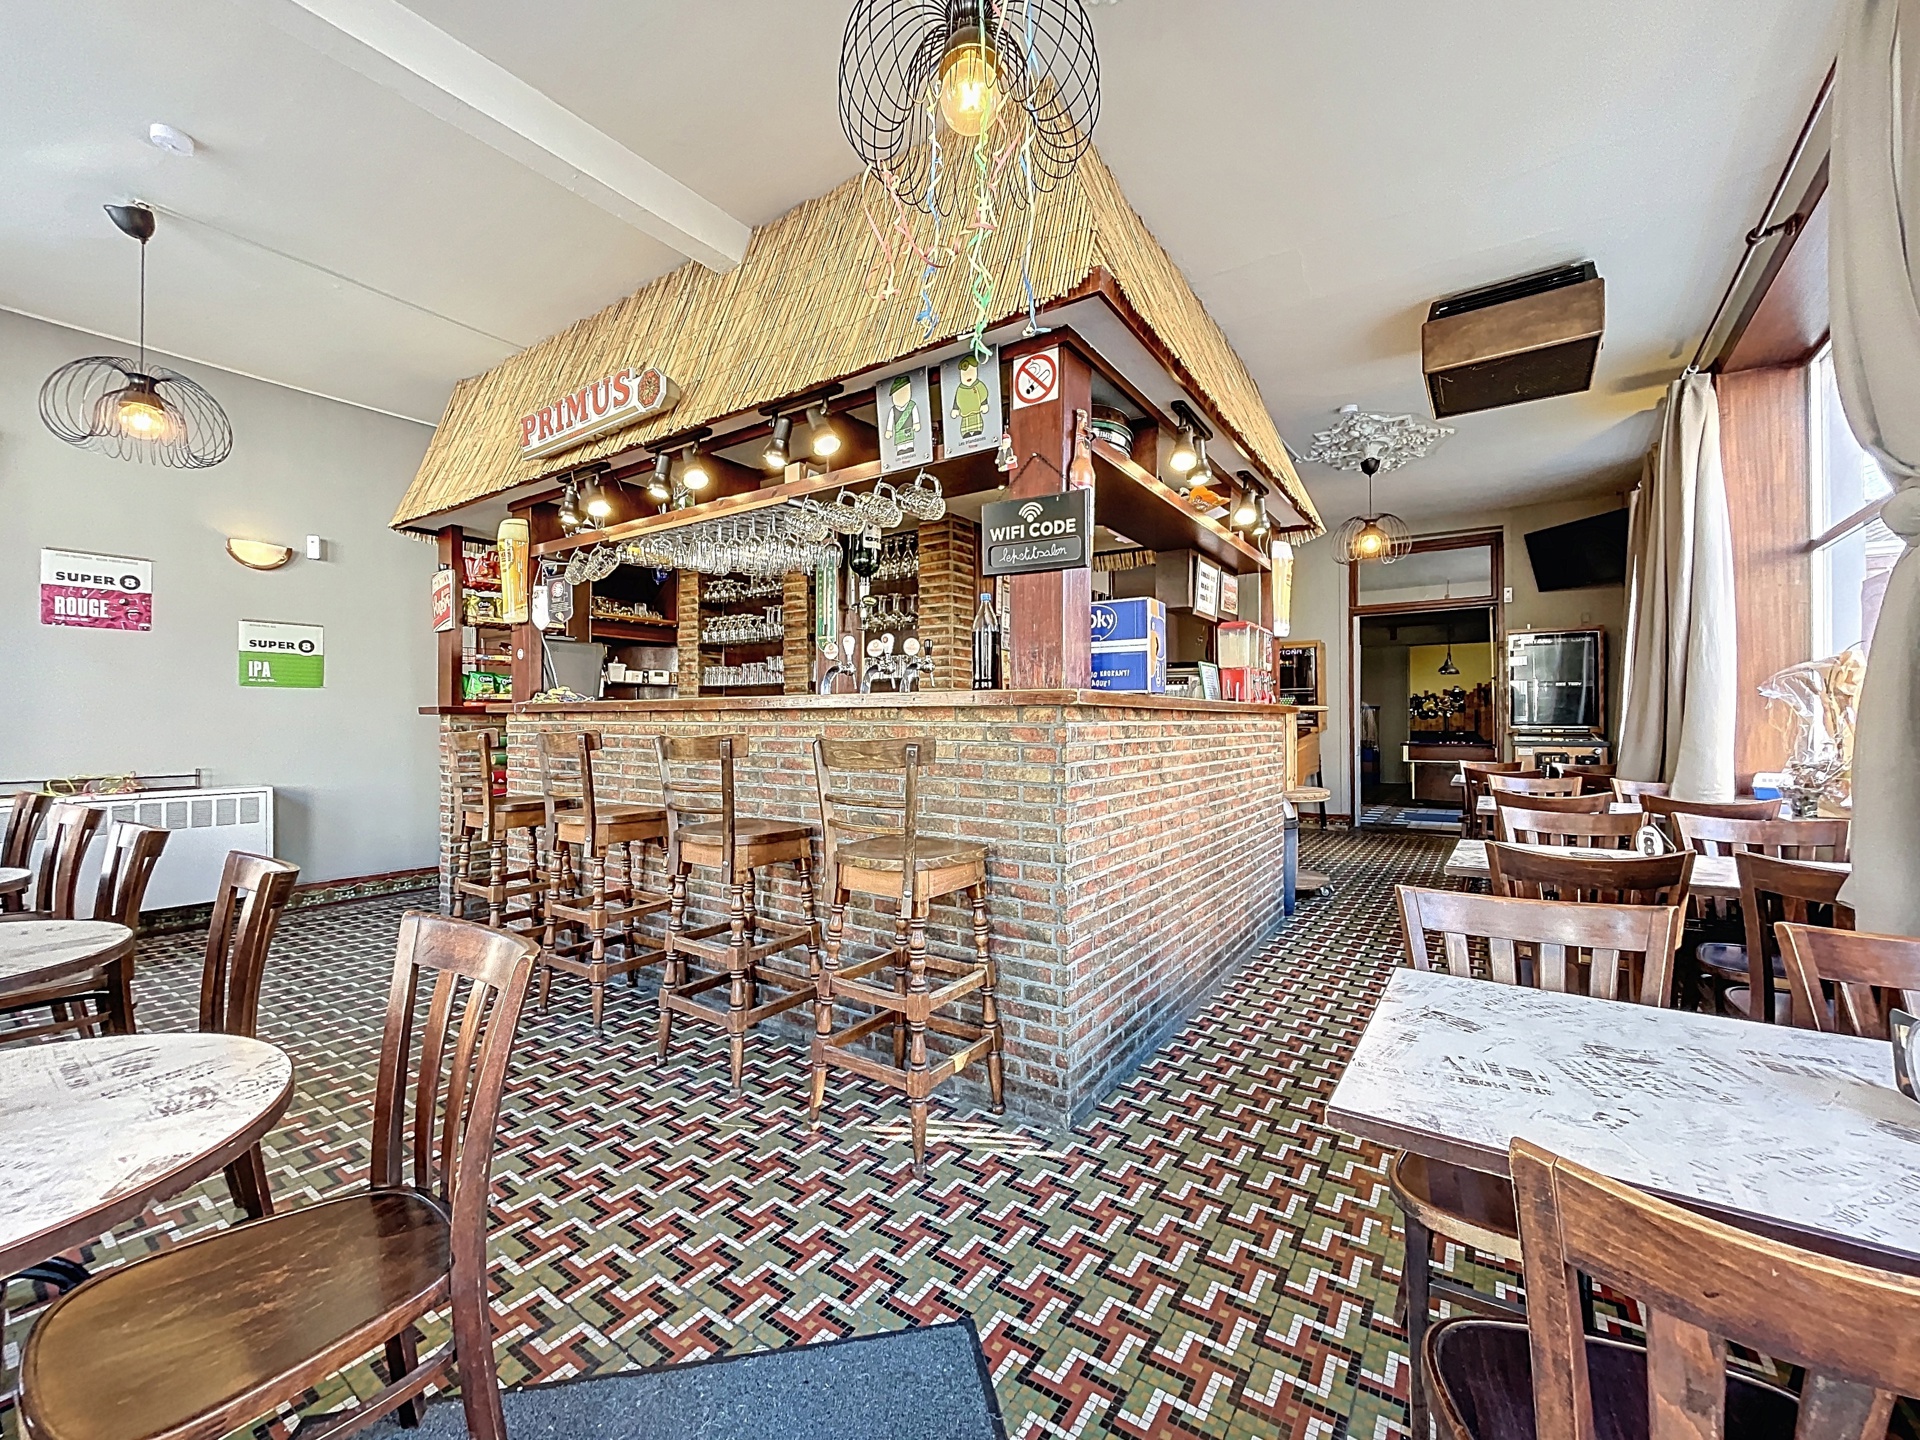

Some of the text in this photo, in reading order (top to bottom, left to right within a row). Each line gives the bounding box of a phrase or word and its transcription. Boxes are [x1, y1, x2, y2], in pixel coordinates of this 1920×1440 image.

[520, 368, 631, 447] PRIMUS
[990, 518, 1077, 542] WIFI CODE
[55, 571, 116, 586] SUPER
[54, 595, 110, 619] ROUGE
[249, 639, 296, 650] SUPER
[248, 660, 271, 678] IPA
